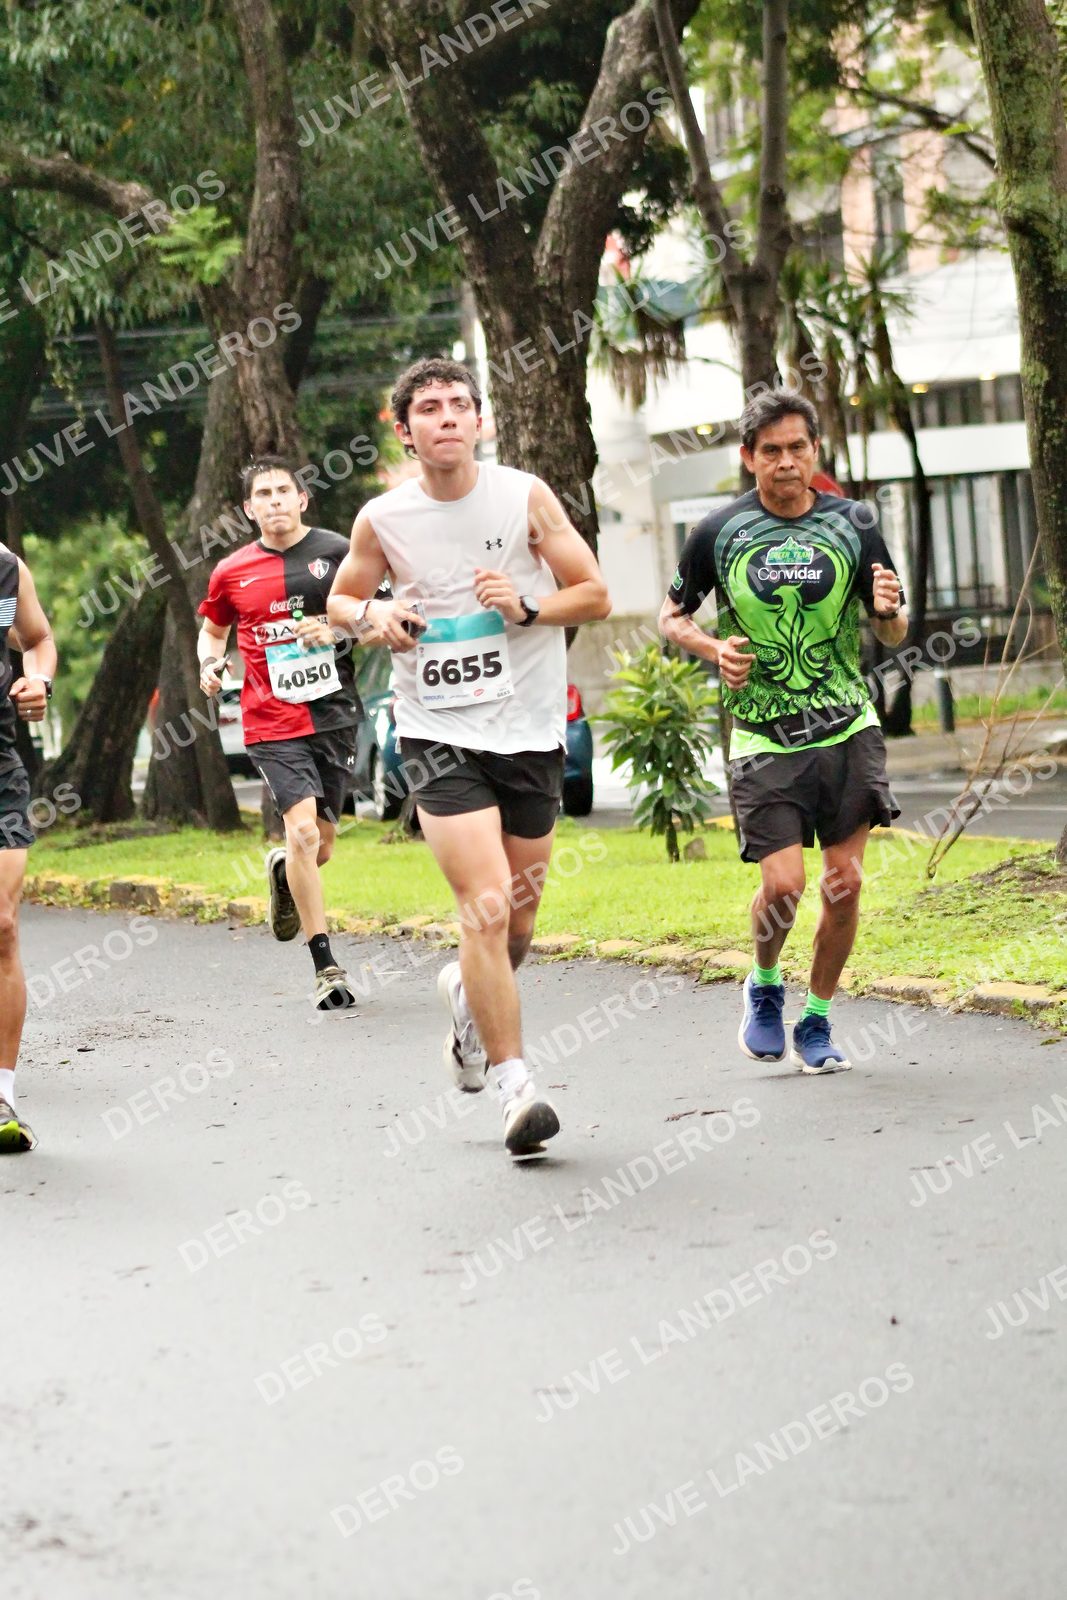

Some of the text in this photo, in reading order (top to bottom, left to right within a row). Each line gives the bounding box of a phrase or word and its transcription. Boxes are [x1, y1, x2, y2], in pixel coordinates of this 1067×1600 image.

[758, 567, 823, 581] Convidar
[277, 662, 332, 691] 4050
[423, 650, 503, 687] 6655
